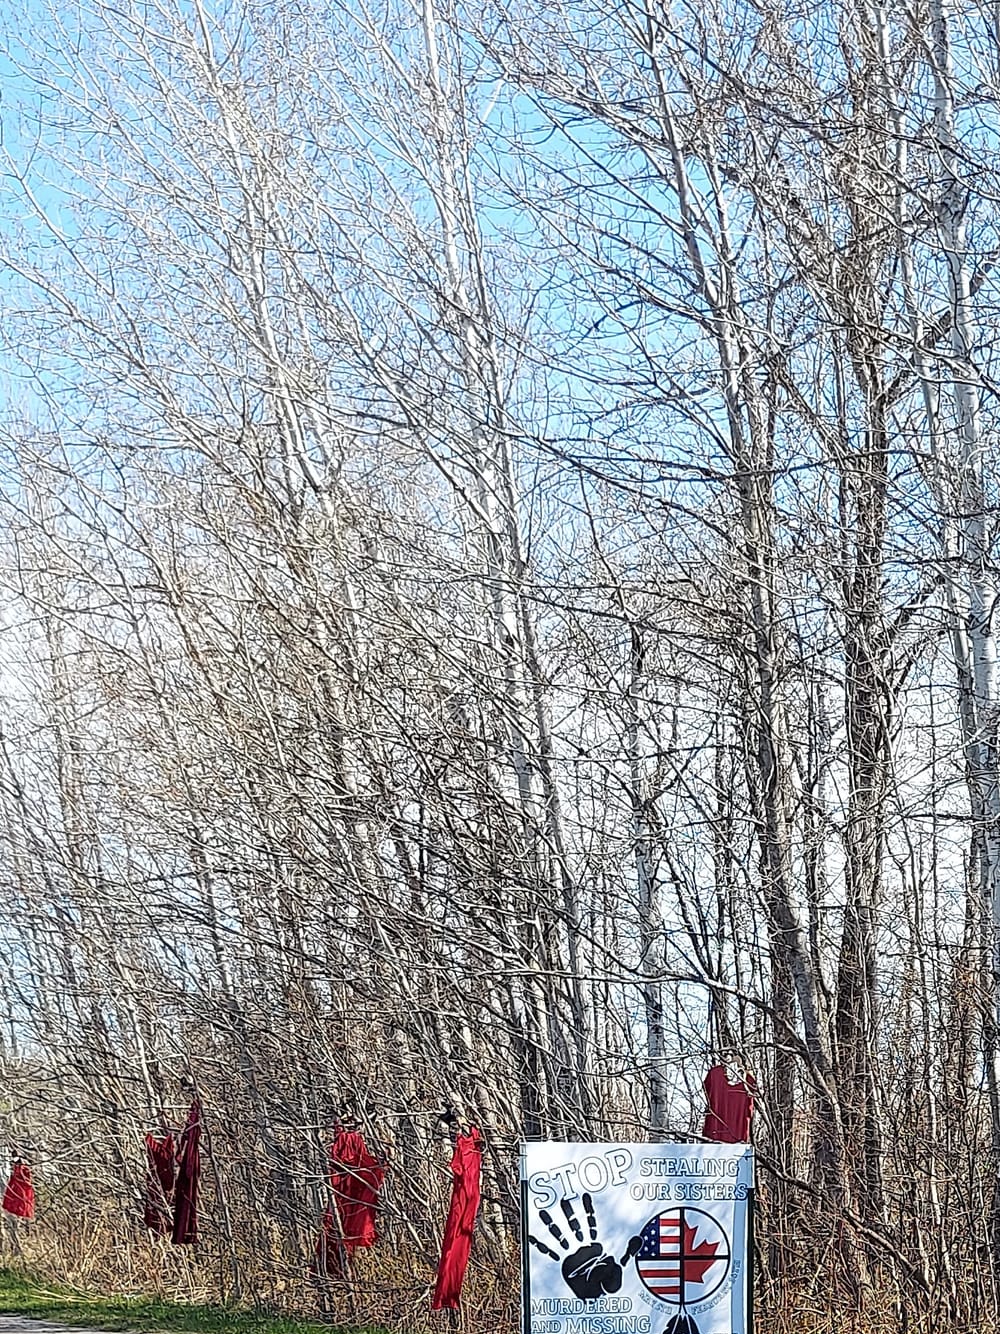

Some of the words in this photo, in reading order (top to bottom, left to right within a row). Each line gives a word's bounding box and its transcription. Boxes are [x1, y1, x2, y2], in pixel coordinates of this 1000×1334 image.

[640, 1158, 739, 1177] STEALING
[529, 1148, 632, 1209] STOP
[630, 1183, 671, 1201] OUR
[674, 1182, 748, 1201] SISTERS
[531, 1297, 633, 1316] MURDERED
[531, 1320, 561, 1334] AND
